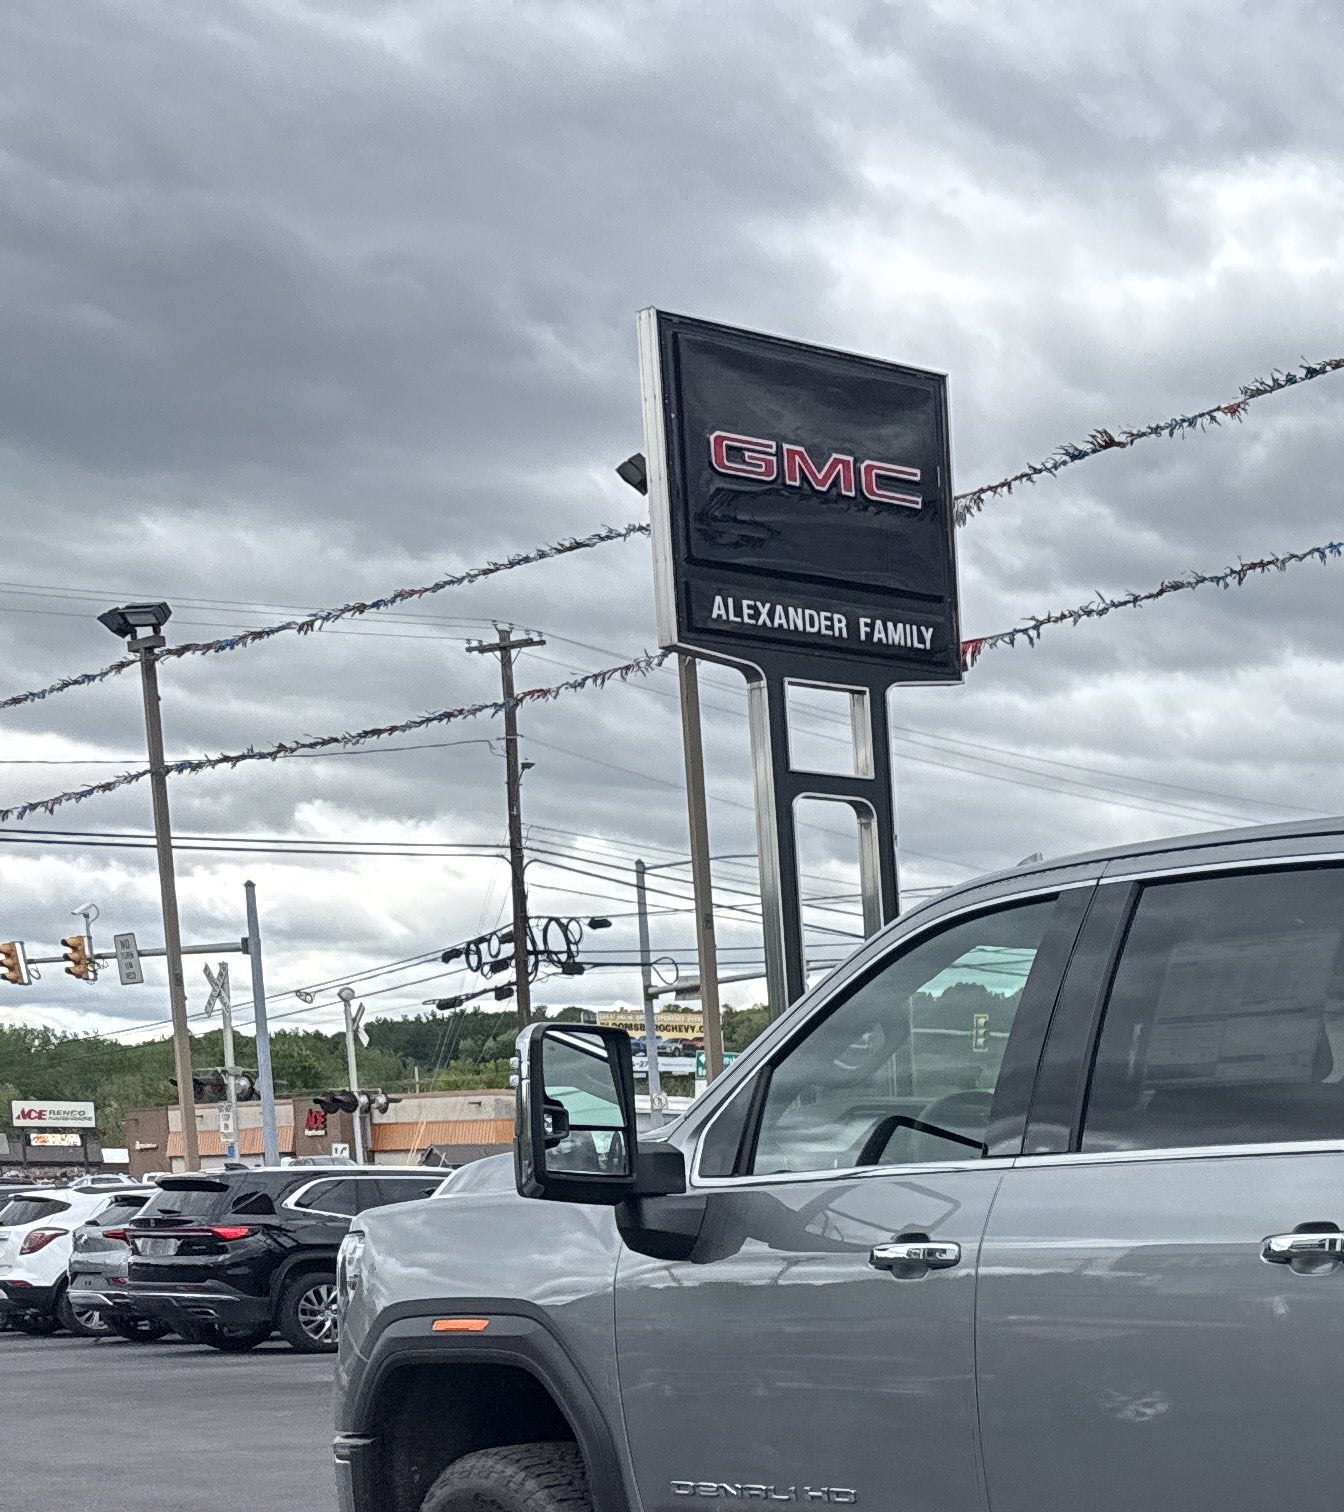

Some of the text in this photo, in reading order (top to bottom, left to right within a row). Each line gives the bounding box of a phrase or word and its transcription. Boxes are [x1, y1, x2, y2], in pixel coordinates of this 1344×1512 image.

[709, 430, 923, 510] GMC
[711, 594, 934, 651] ALEXANDER FAMILY
[15, 1107, 48, 1121] ACE
[670, 1480, 857, 1504] DENALI HD
